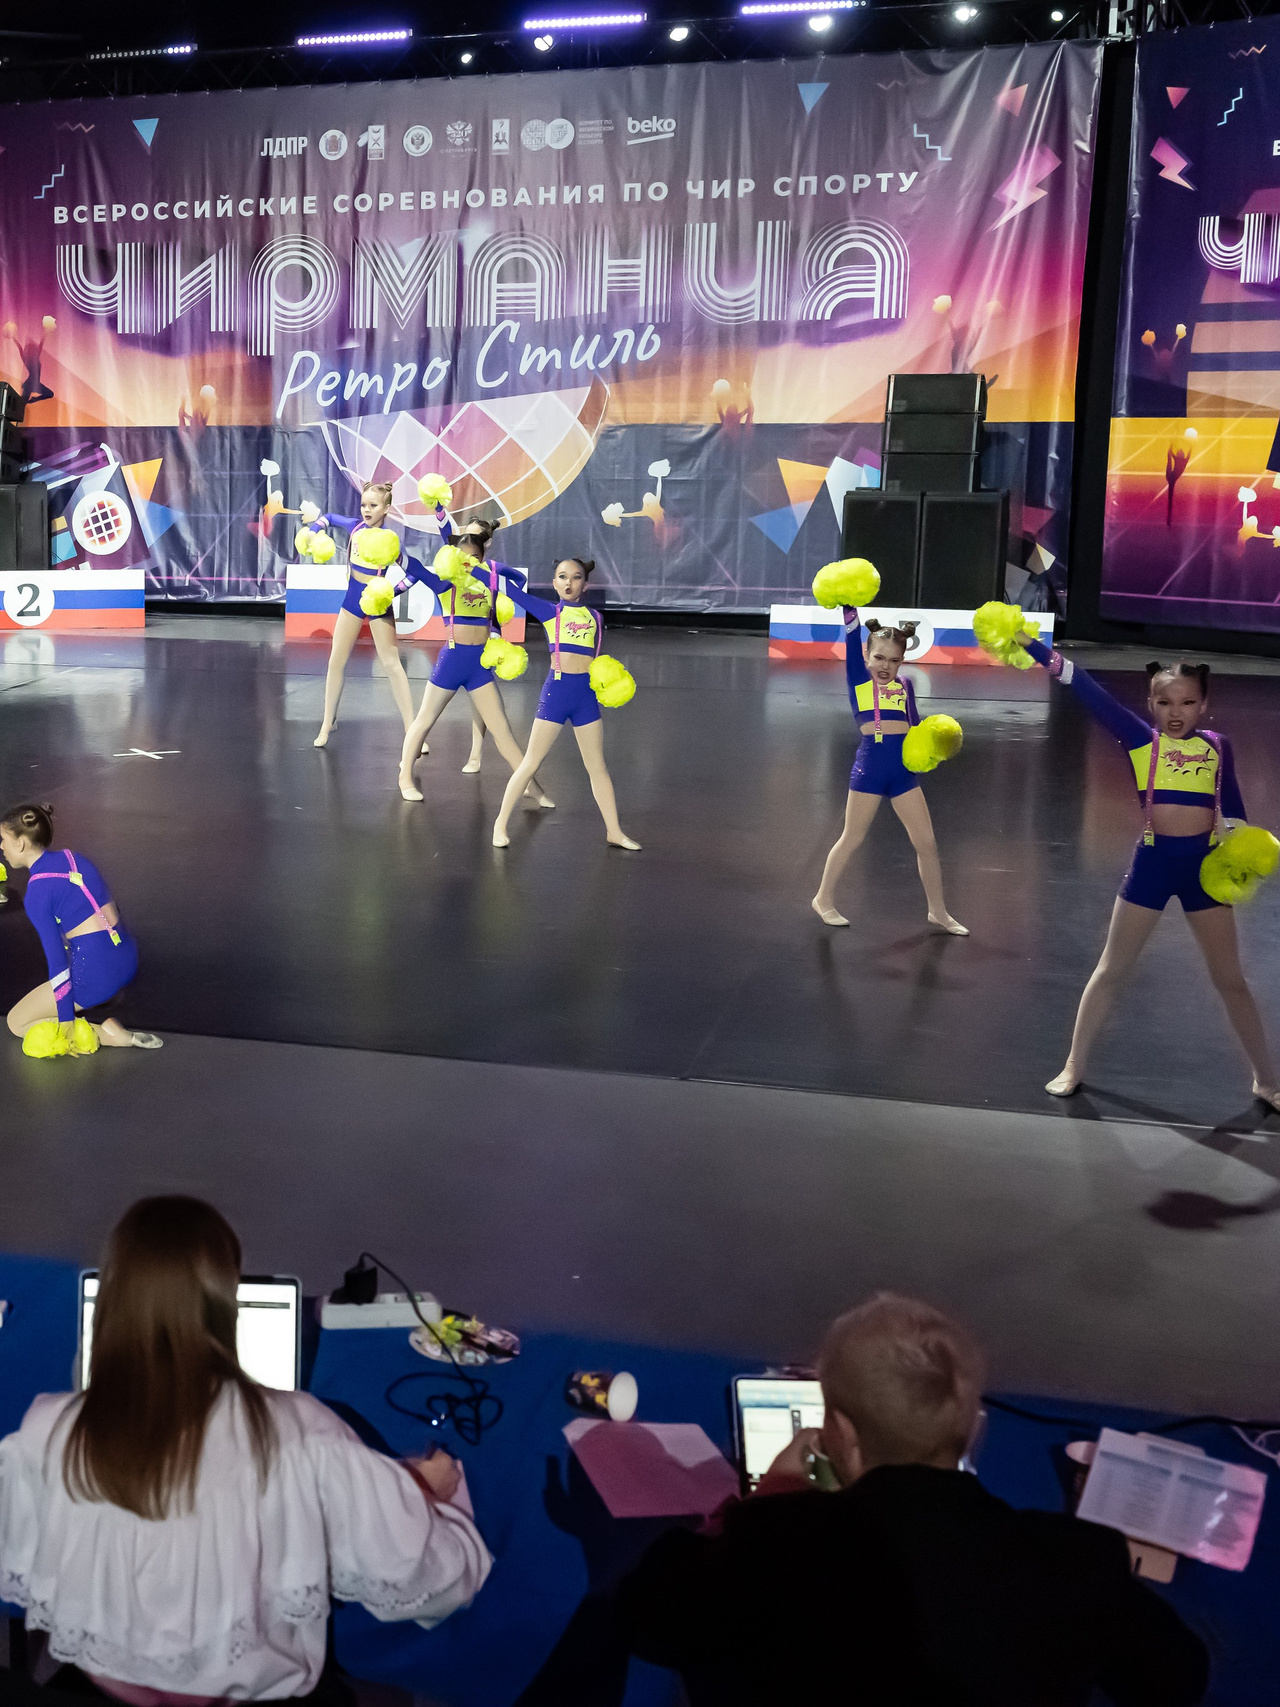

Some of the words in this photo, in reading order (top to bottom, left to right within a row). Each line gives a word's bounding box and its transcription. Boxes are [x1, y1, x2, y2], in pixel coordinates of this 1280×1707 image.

[627, 116, 677, 134] beko
[260, 136, 308, 158] ЛДПР
[54, 195, 317, 224] ВСЕРОССИЙСКИЕ
[333, 183, 604, 213] СОРЕВНОВАНИЯ
[623, 181, 669, 202] ПО
[686, 177, 755, 199] ЧИР
[773, 171, 918, 196] СПОРТУ
[275, 350, 451, 418] Ретро
[476, 319, 661, 388] Стиль
[17, 583, 40, 617] 2
